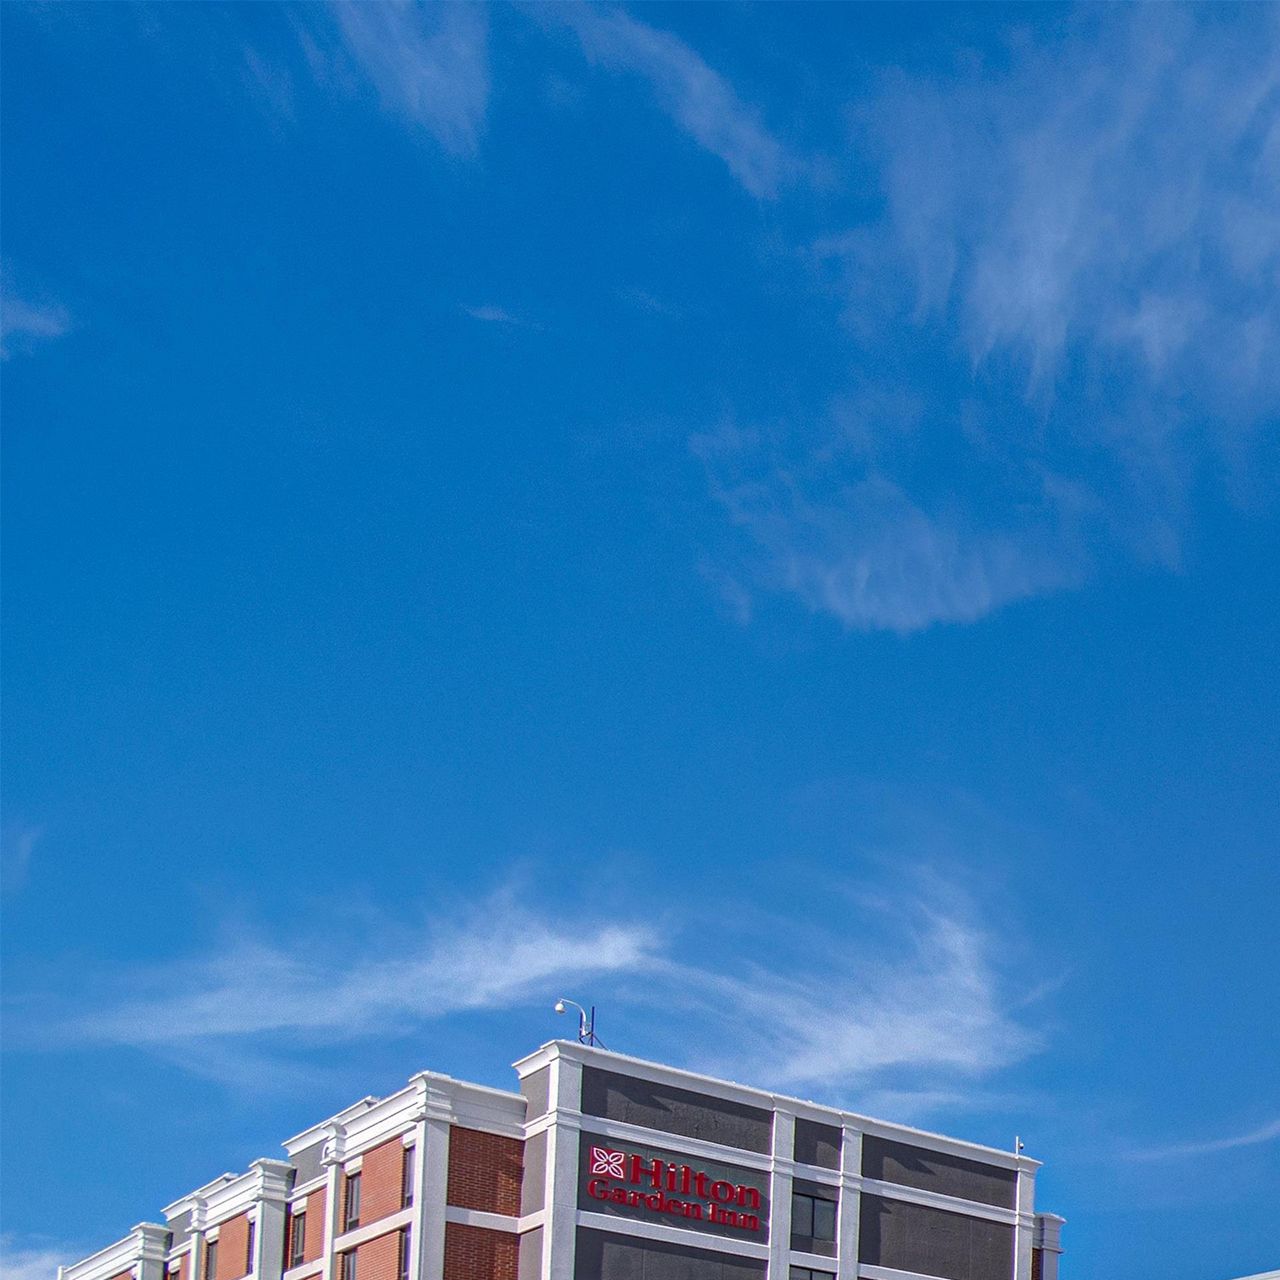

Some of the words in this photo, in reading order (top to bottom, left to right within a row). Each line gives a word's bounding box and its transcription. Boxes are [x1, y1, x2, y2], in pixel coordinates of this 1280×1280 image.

[587, 1178, 703, 1221] Garden
[707, 1201, 761, 1232] Inn
[628, 1153, 761, 1210] Hilton
